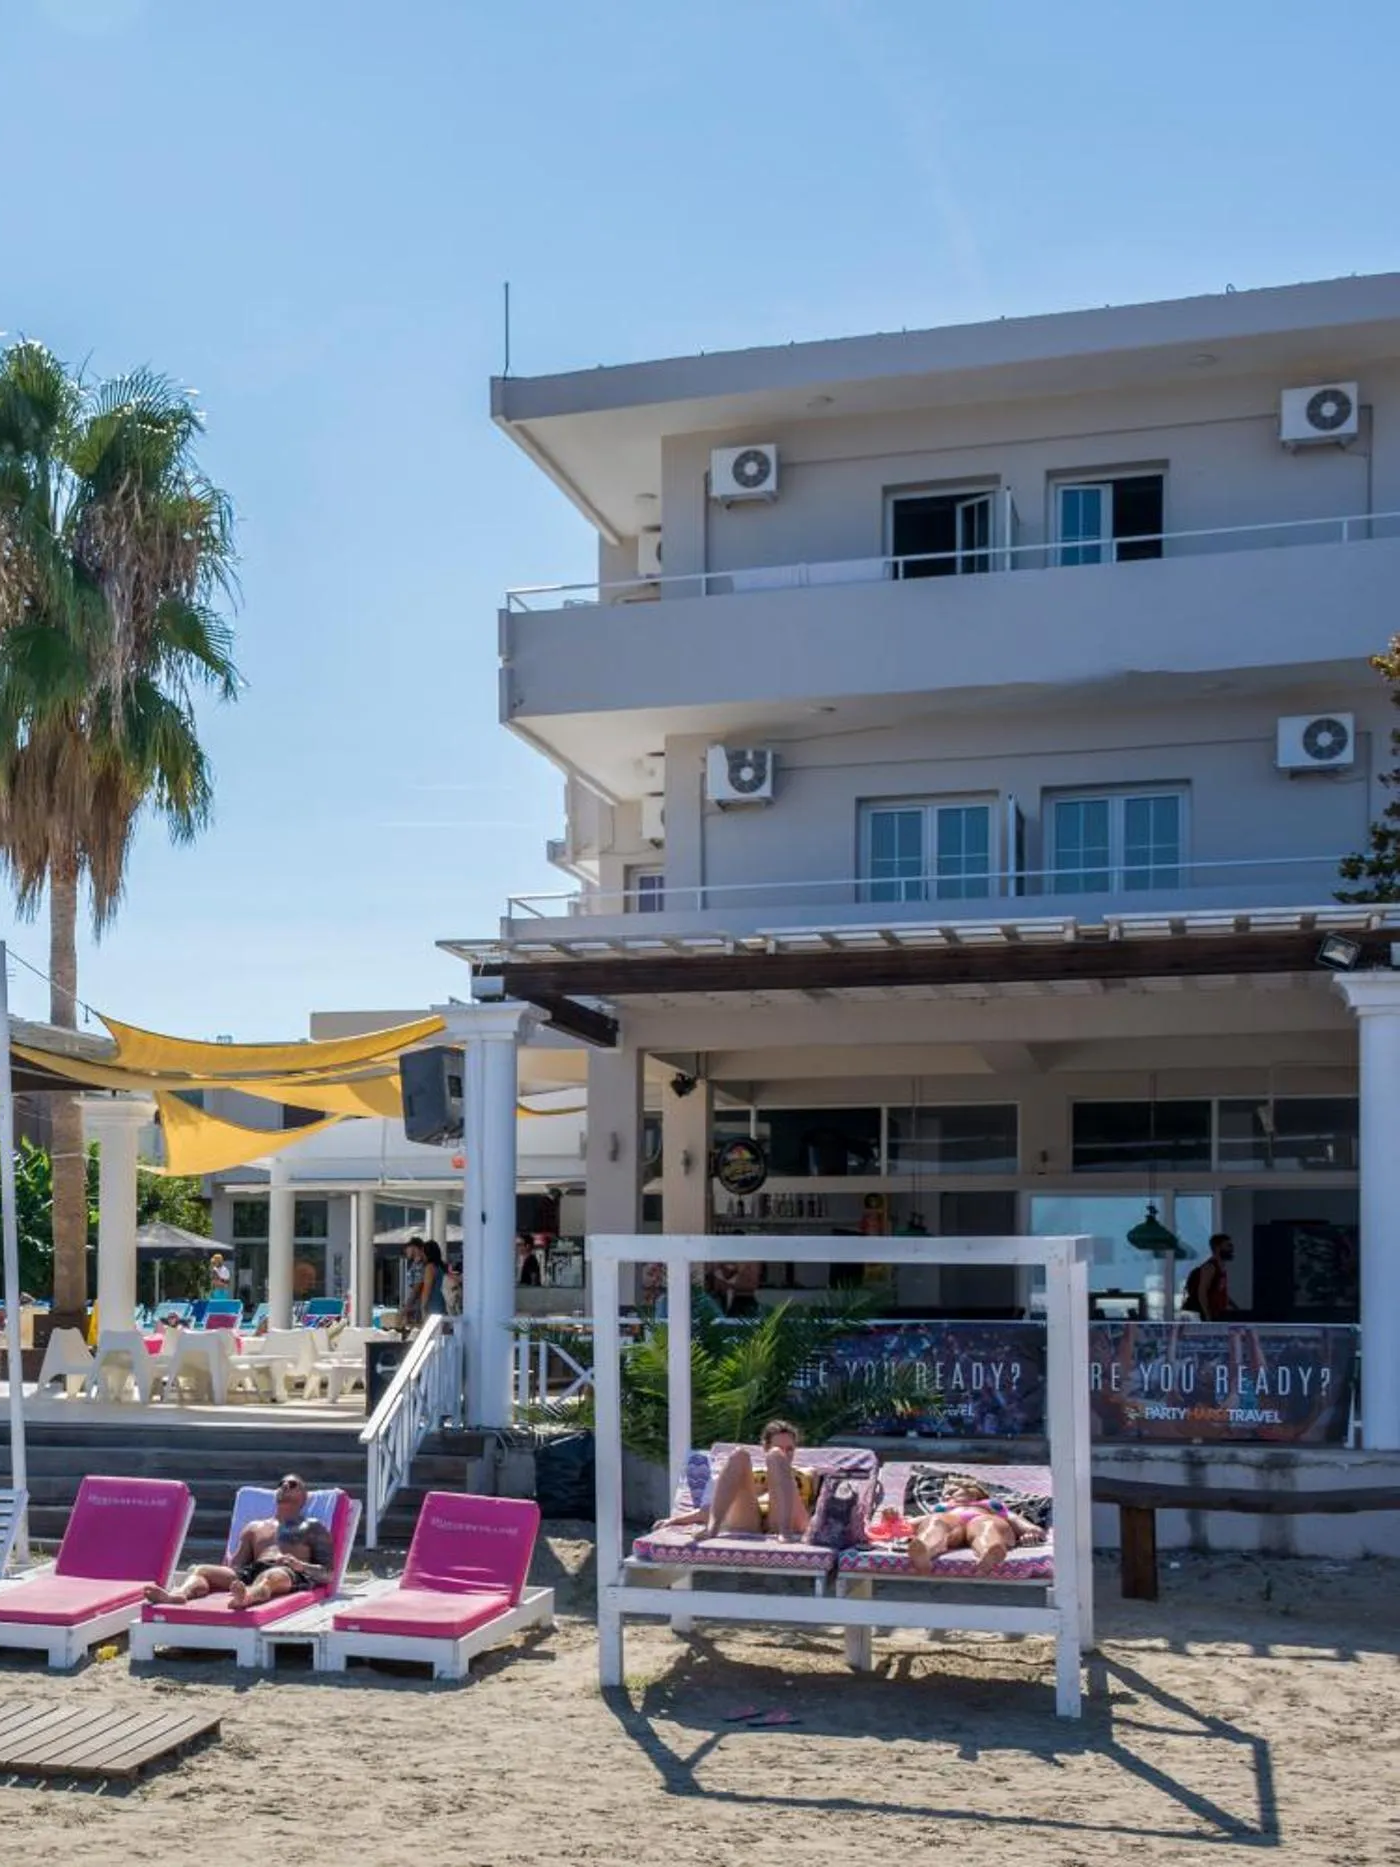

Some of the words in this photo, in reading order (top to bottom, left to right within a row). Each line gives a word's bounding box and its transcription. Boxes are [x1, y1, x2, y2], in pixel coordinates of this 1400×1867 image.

[915, 1361, 1021, 1391] READY?
[1090, 1361, 1121, 1392] RE
[1139, 1362, 1195, 1393] YOU
[1216, 1363, 1332, 1397] READY?
